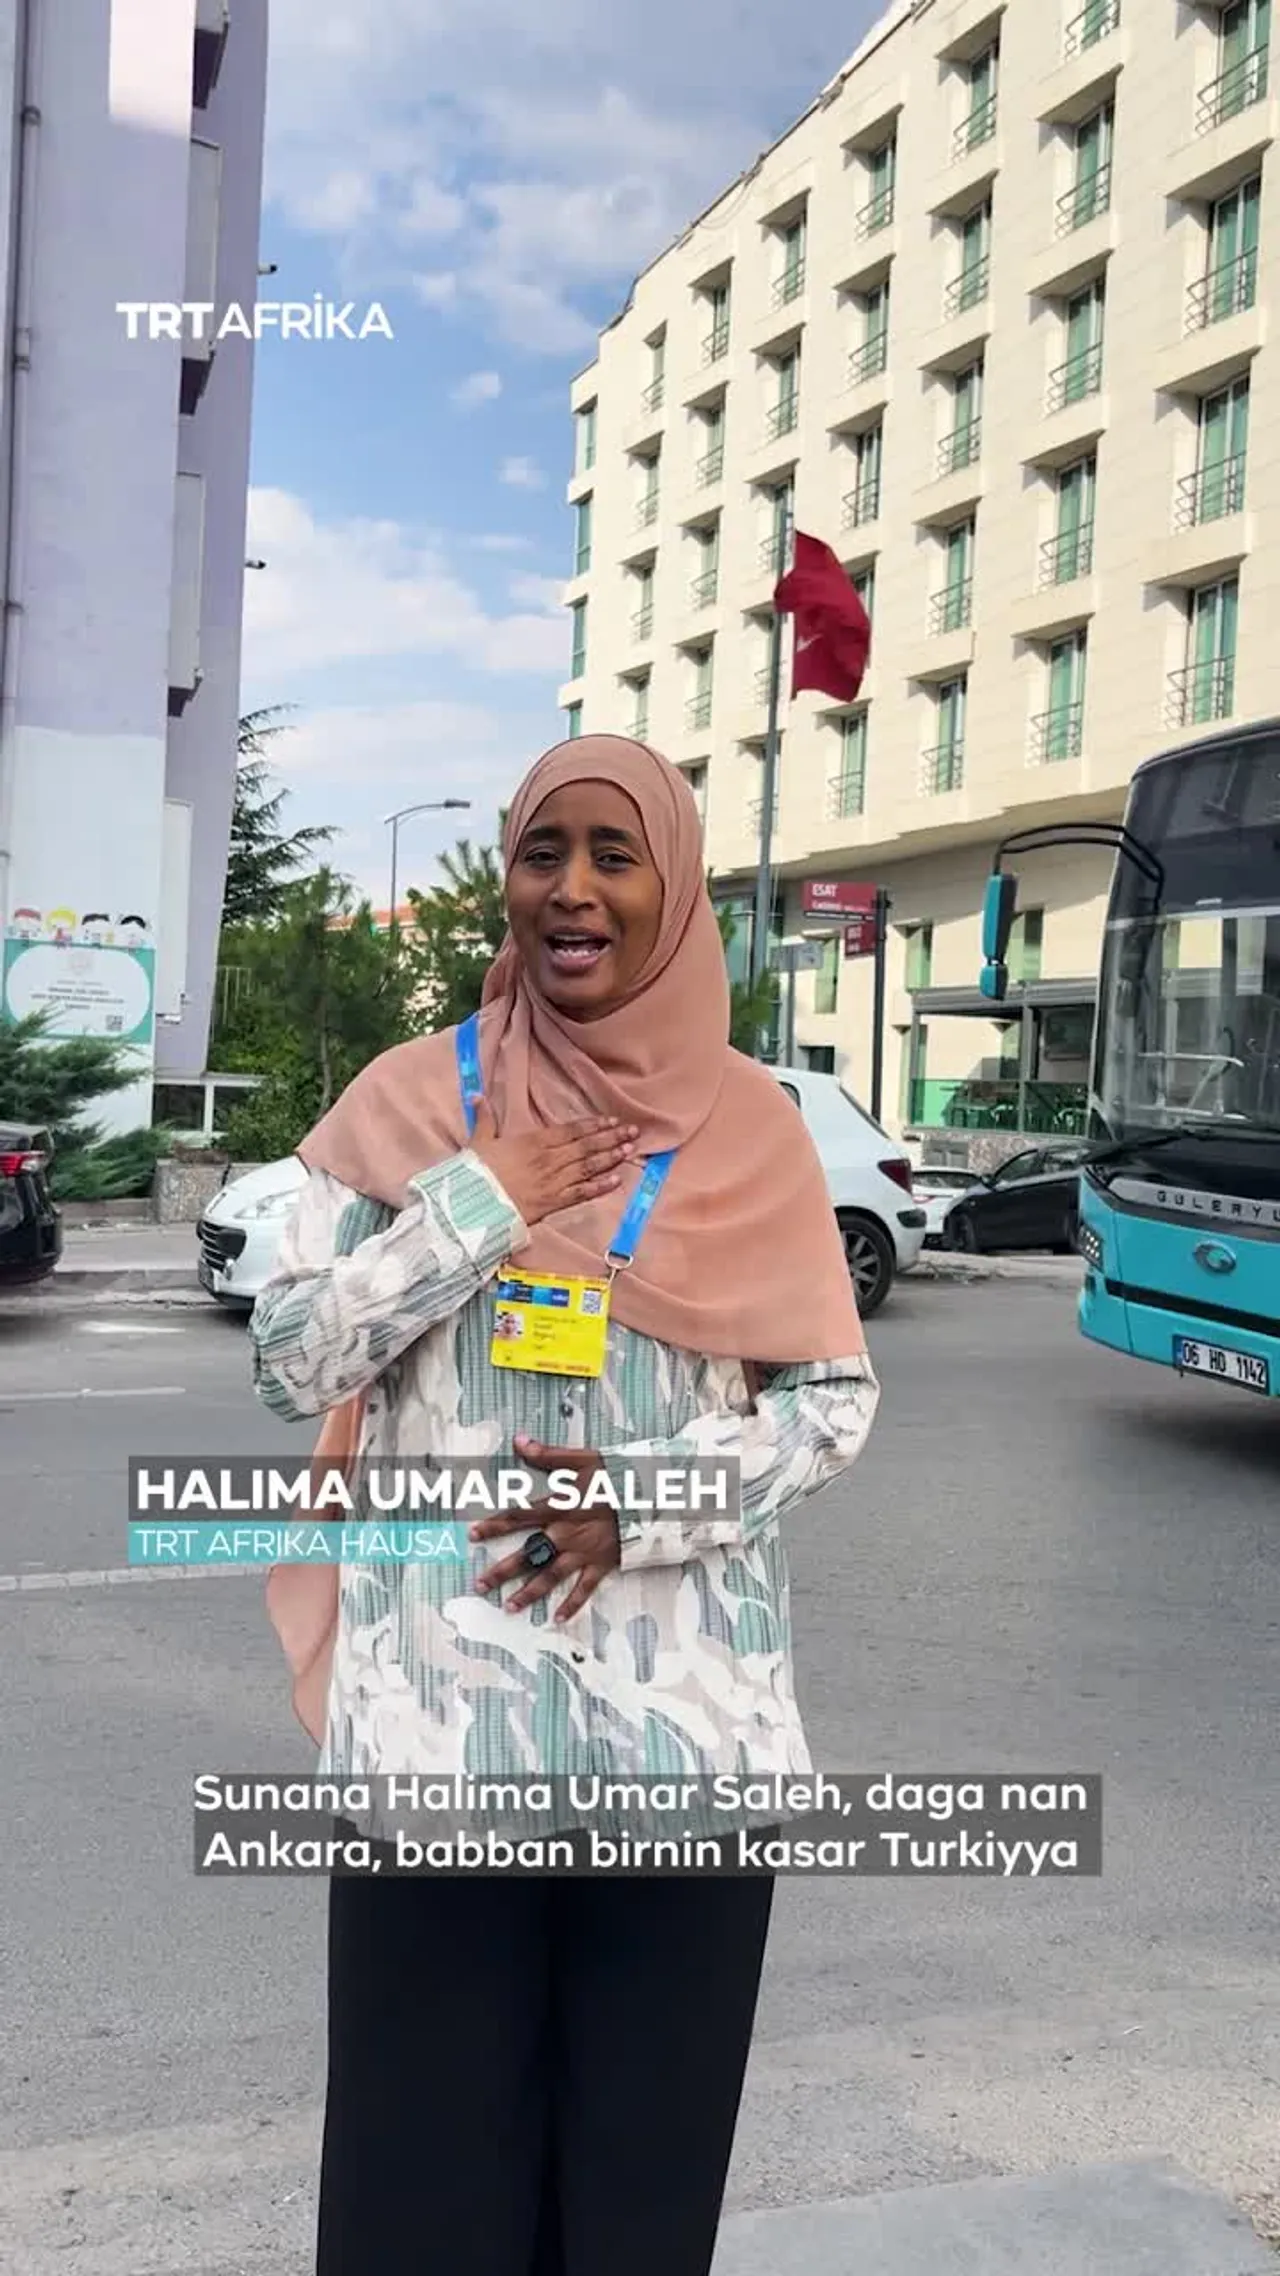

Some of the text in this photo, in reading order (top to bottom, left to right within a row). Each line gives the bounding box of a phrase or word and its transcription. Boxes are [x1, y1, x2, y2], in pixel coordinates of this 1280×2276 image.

[812, 883, 838, 897] ESAT
[1183, 1343, 1266, 1385] 06 HD 1142
